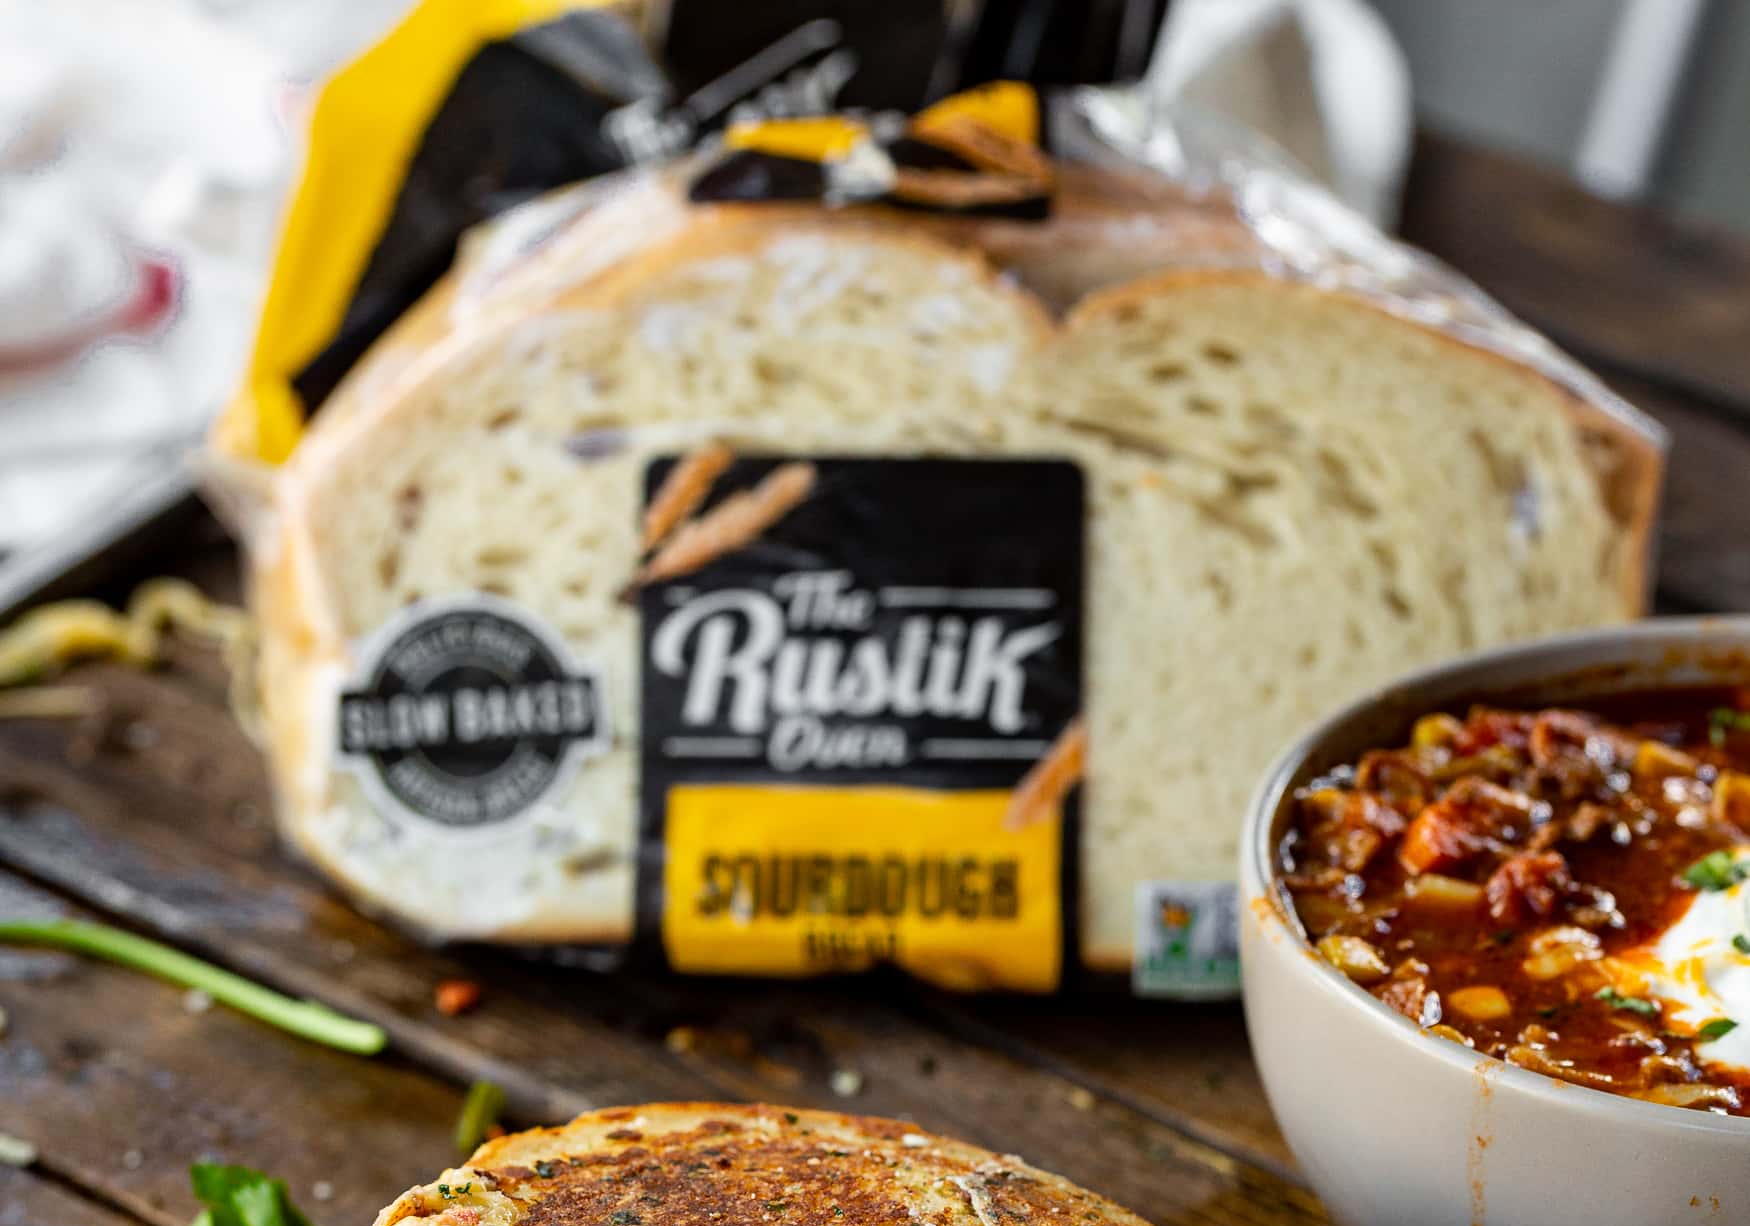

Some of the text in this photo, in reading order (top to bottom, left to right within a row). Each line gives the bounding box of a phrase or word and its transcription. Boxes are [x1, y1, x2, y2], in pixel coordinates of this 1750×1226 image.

[773, 570, 876, 630] The
[651, 588, 1061, 735] Rustik
[766, 711, 908, 772] Oven
[694, 853, 1020, 922] SOURDOUGH
